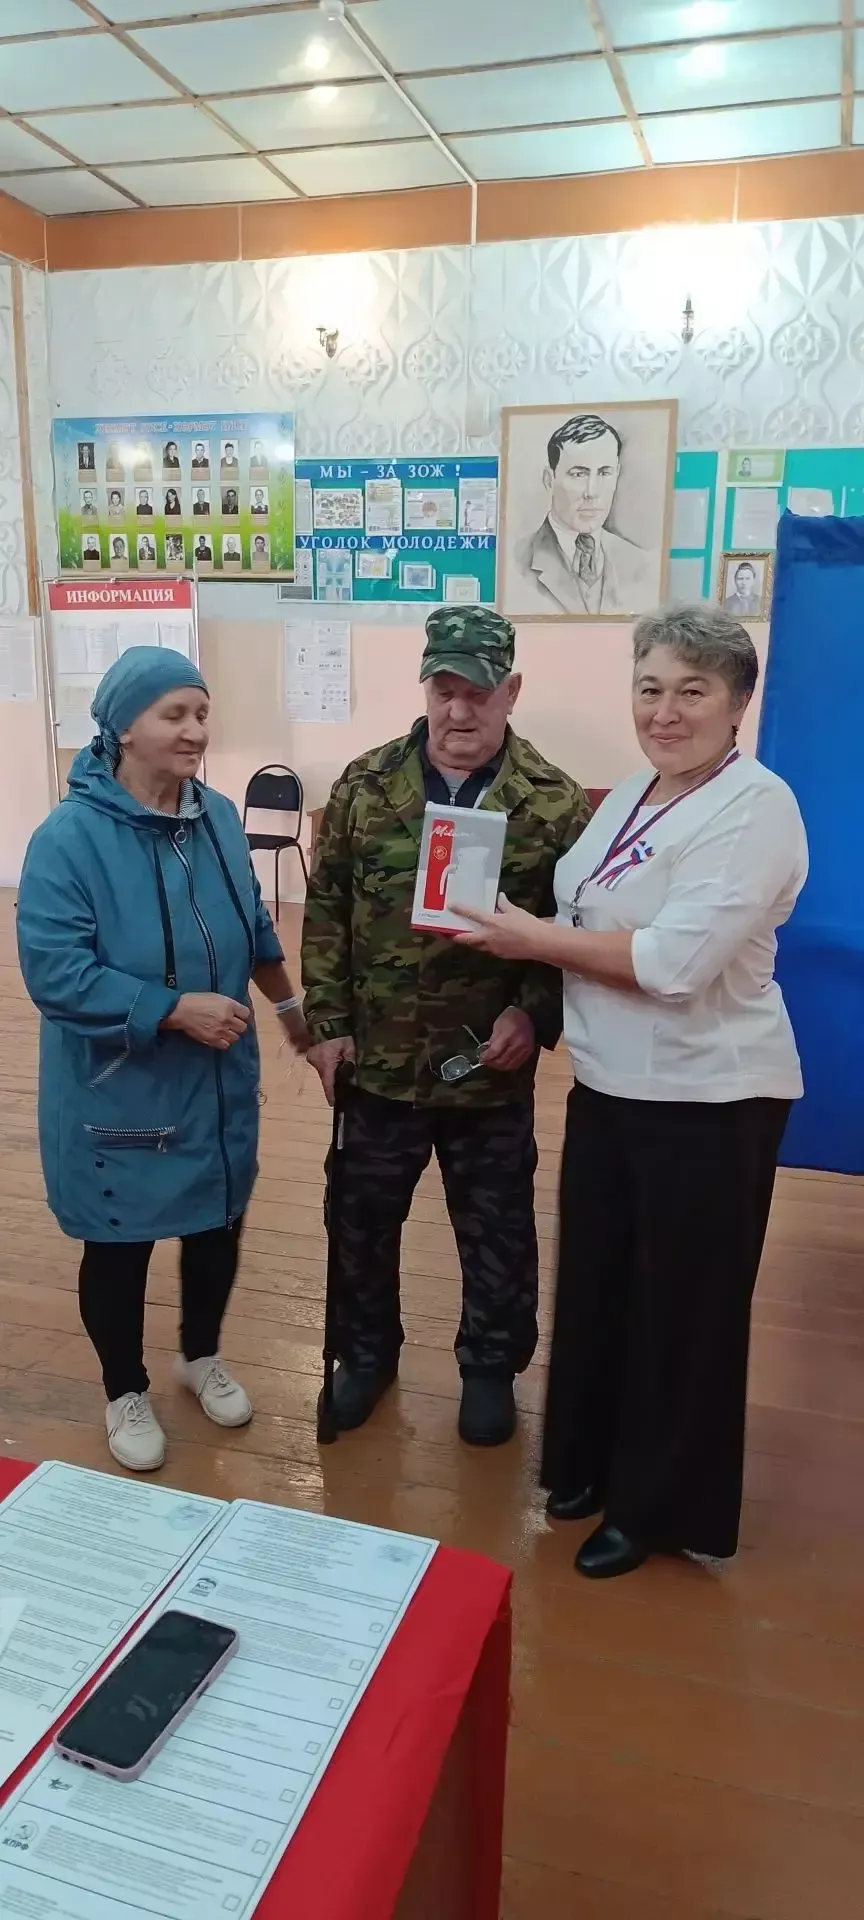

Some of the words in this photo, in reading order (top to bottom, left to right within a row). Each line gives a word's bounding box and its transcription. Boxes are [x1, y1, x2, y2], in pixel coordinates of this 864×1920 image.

[320, 465, 352, 478] МЫ
[376, 465, 397, 478] ЗА
[408, 464, 446, 478] ЗОЖ
[300, 536, 372, 550] УГОЛОК
[382, 535, 490, 552] МОЛОДЕЖИ
[66, 588, 175, 604] ИНФОРМАЦИЯ
